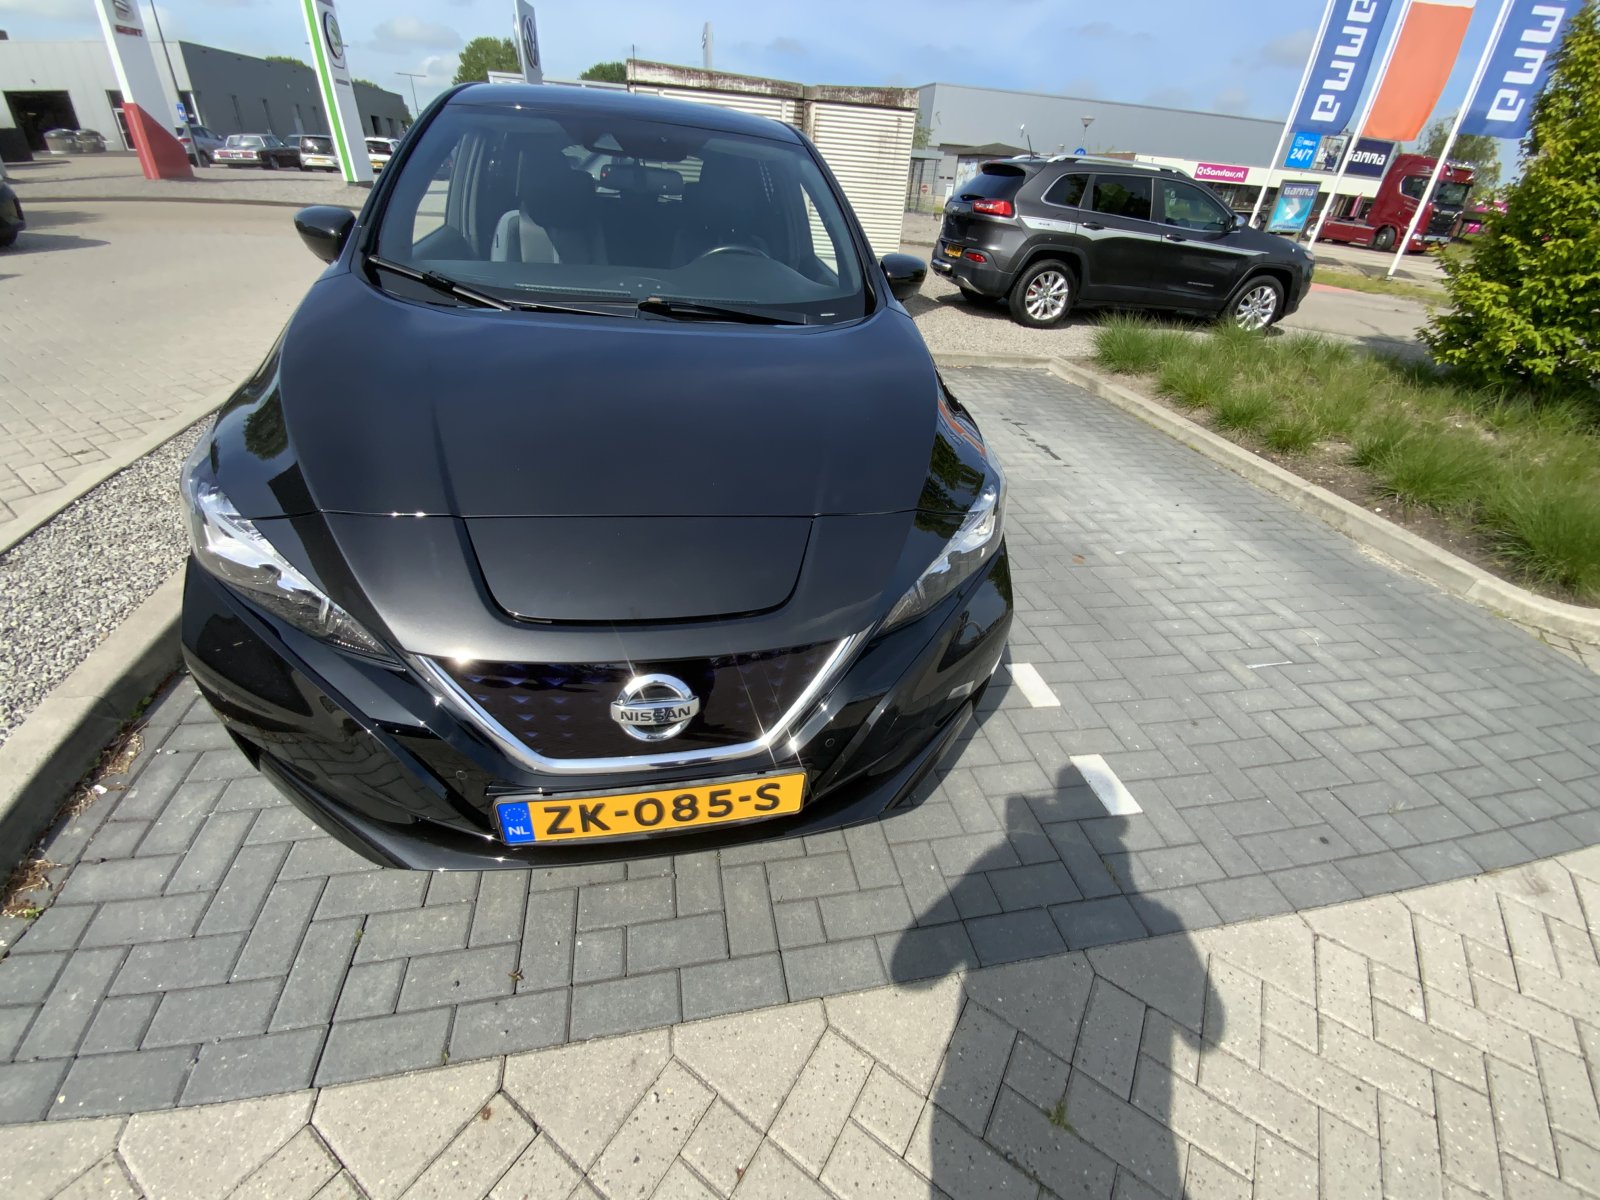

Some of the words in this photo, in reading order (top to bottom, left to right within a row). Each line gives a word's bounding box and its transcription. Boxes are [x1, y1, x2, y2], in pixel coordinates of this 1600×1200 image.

[1290, 148, 1313, 162] 24/7
[620, 706, 691, 722] NISSAN
[544, 783, 781, 836] ZK-085-S
[508, 826, 531, 837] NL
